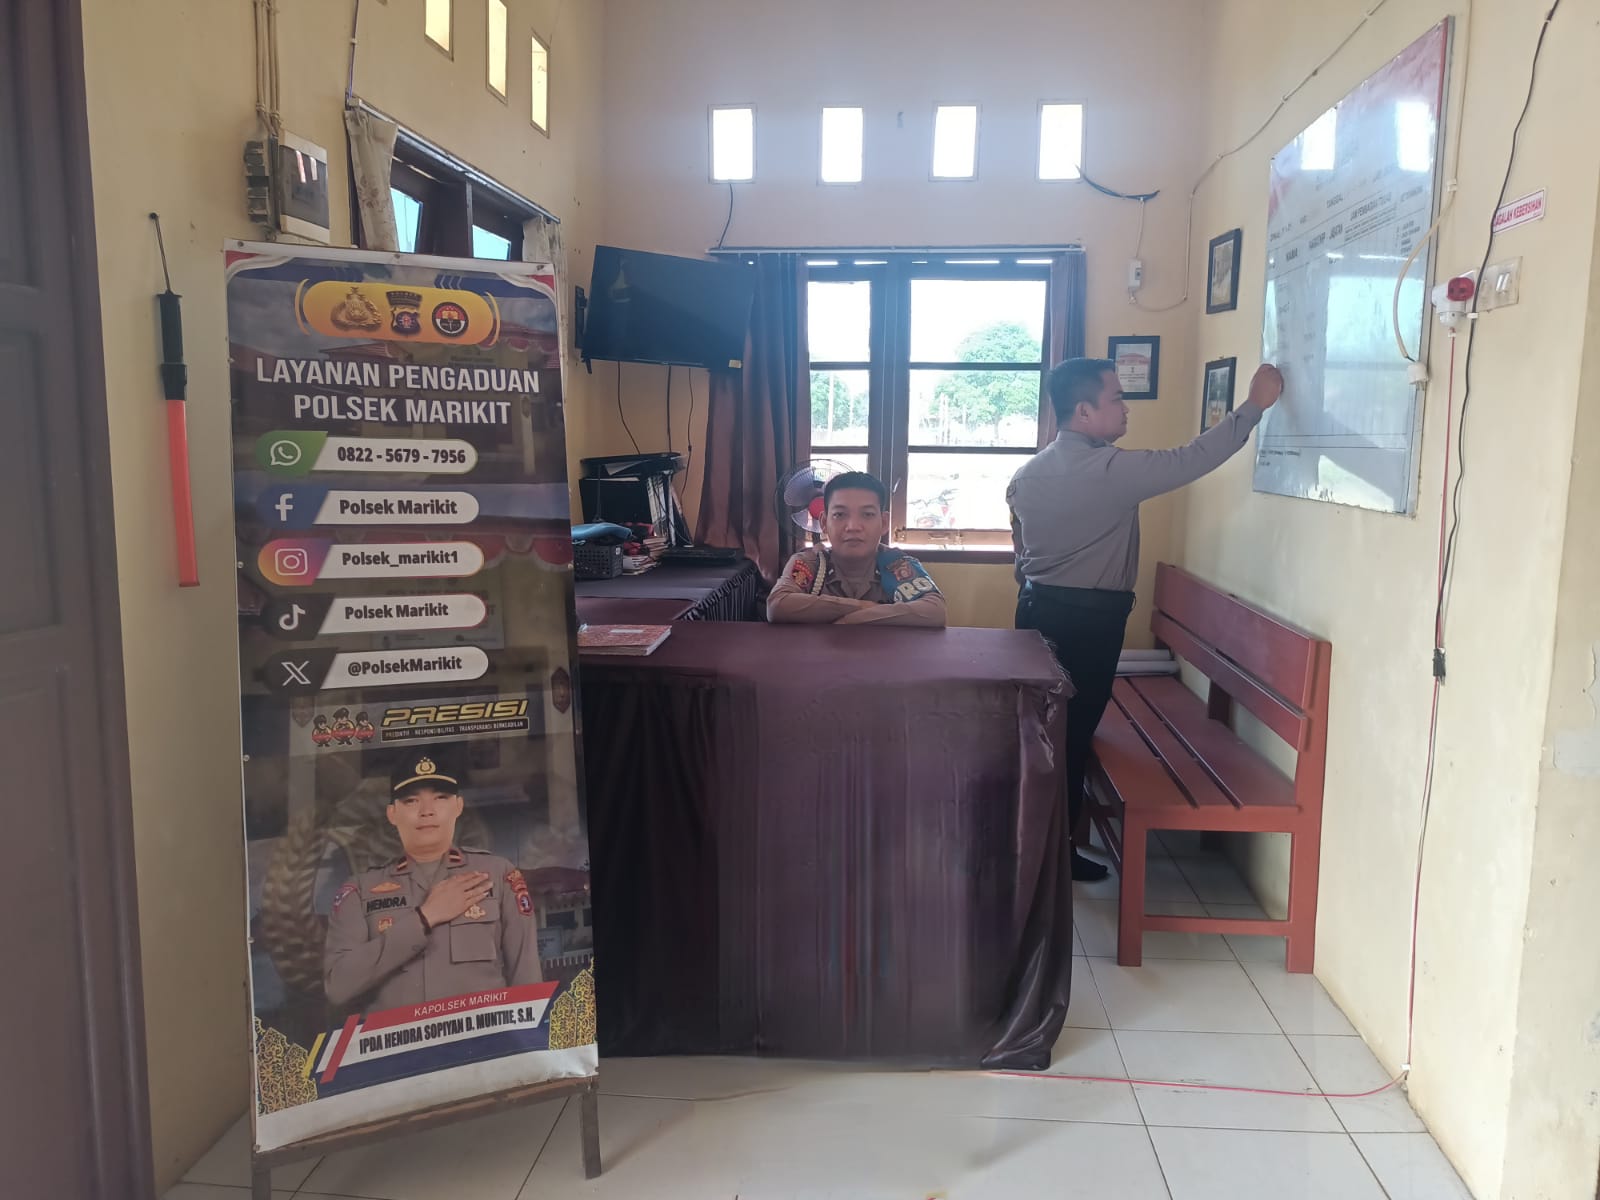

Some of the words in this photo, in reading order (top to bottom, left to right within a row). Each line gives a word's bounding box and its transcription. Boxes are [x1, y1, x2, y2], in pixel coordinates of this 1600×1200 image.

[256, 357, 381, 387] LAYANAN
[389, 364, 540, 393] PENGADUAN
[294, 394, 398, 422] POLSEK
[405, 399, 511, 425] MARIKIT
[337, 446, 373, 463] 0822
[385, 448, 420, 463] 5679
[431, 449, 466, 464] 7956
[339, 499, 394, 515] Polsek
[398, 499, 458, 514] Marikit
[342, 550, 459, 568] Polsek_marikit1
[344, 604, 393, 620] Polsek
[395, 603, 449, 618] Marikit
[348, 657, 462, 677] @PolsekMarikit
[381, 700, 529, 727] PRESISI
[366, 895, 407, 913] HENDRA
[414, 998, 466, 1017] KAPOLSEK
[469, 991, 508, 1006] MARIKIT
[359, 1037, 383, 1055] IPDA
[385, 1029, 423, 1049] HENDRA
[424, 1019, 464, 1041] SOPIYAN
[466, 1018, 475, 1031] D.
[476, 1009, 516, 1029] MUNTHE,
[517, 1006, 535, 1023] S.H.
